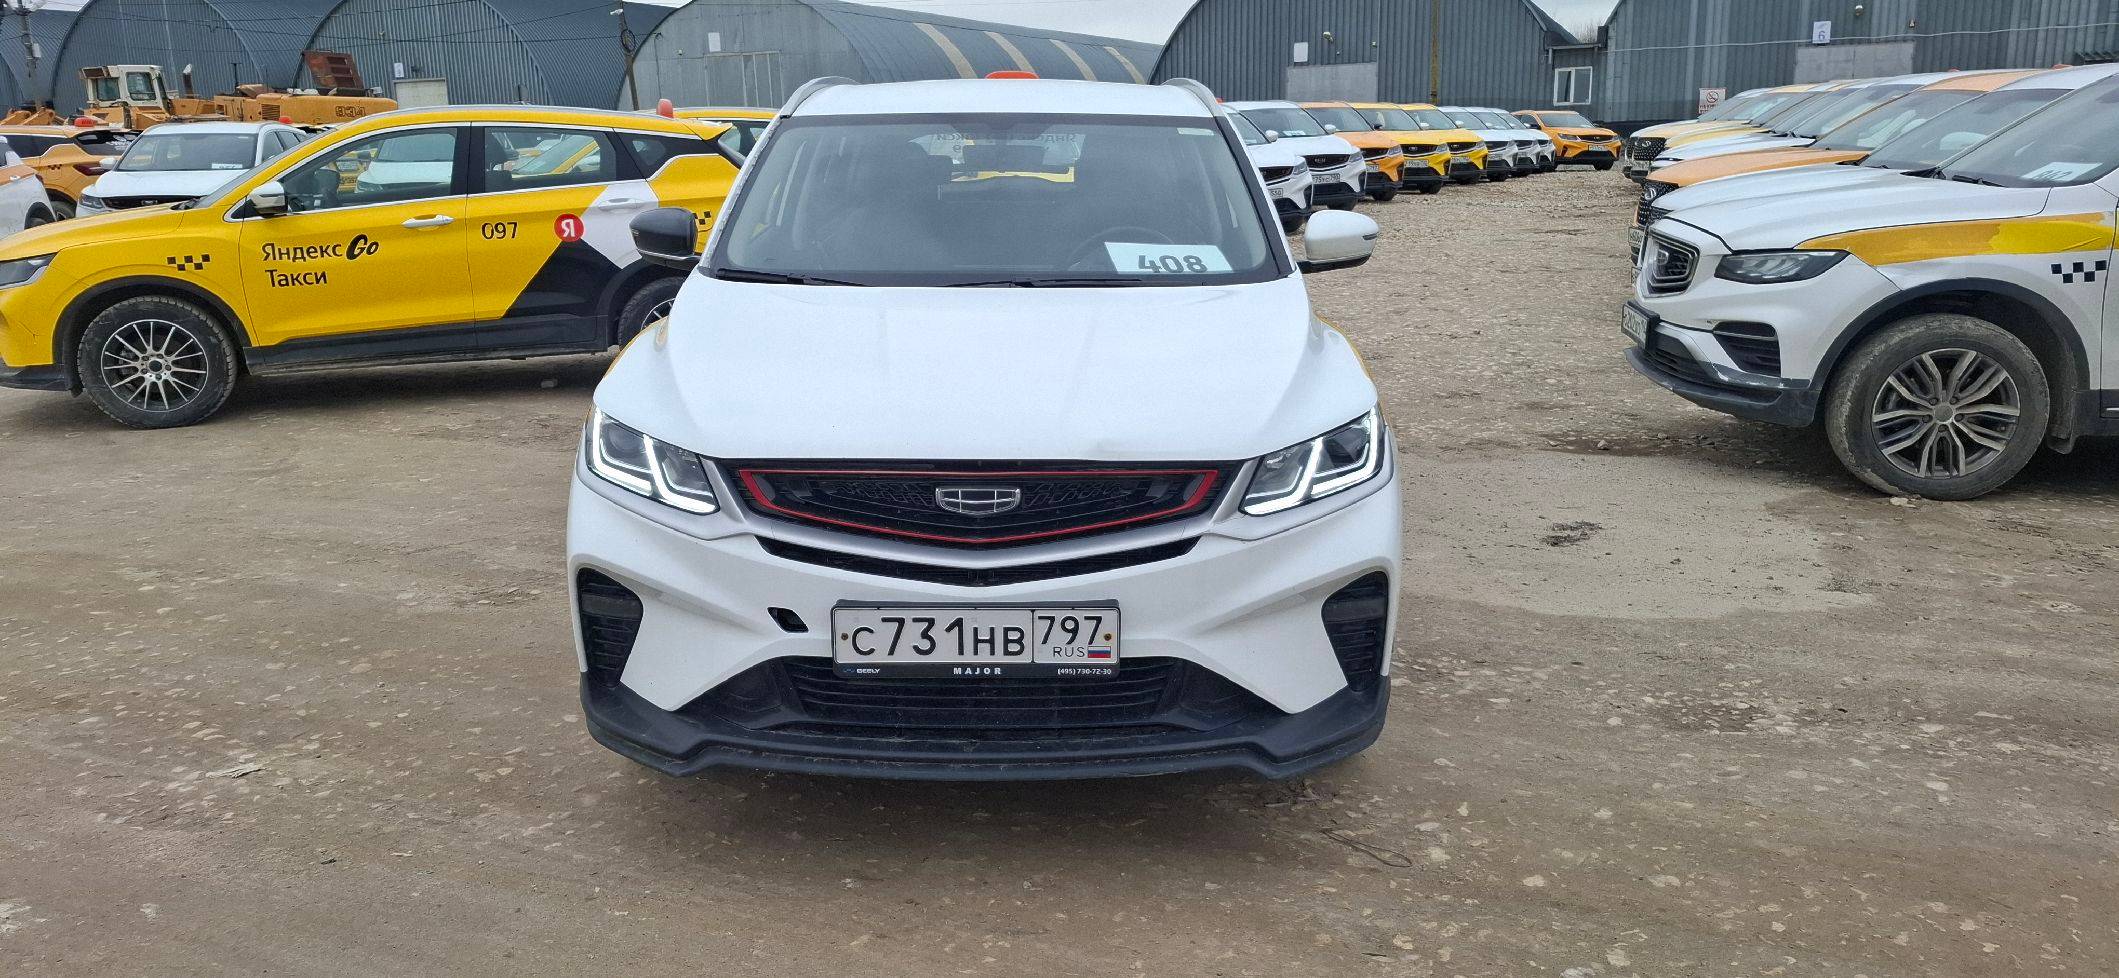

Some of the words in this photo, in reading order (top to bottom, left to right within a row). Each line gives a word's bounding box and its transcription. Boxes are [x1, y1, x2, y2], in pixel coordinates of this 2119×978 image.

[481, 222, 518, 240] 097
[561, 219, 575, 237] Я
[262, 242, 343, 262] Яндекс
[346, 234, 380, 260] Go
[1138, 255, 1208, 273] 408
[265, 269, 327, 287] Такси
[1038, 615, 1102, 645] 797
[1053, 646, 1085, 658] RUS
[953, 667, 1002, 675] MAJOR
